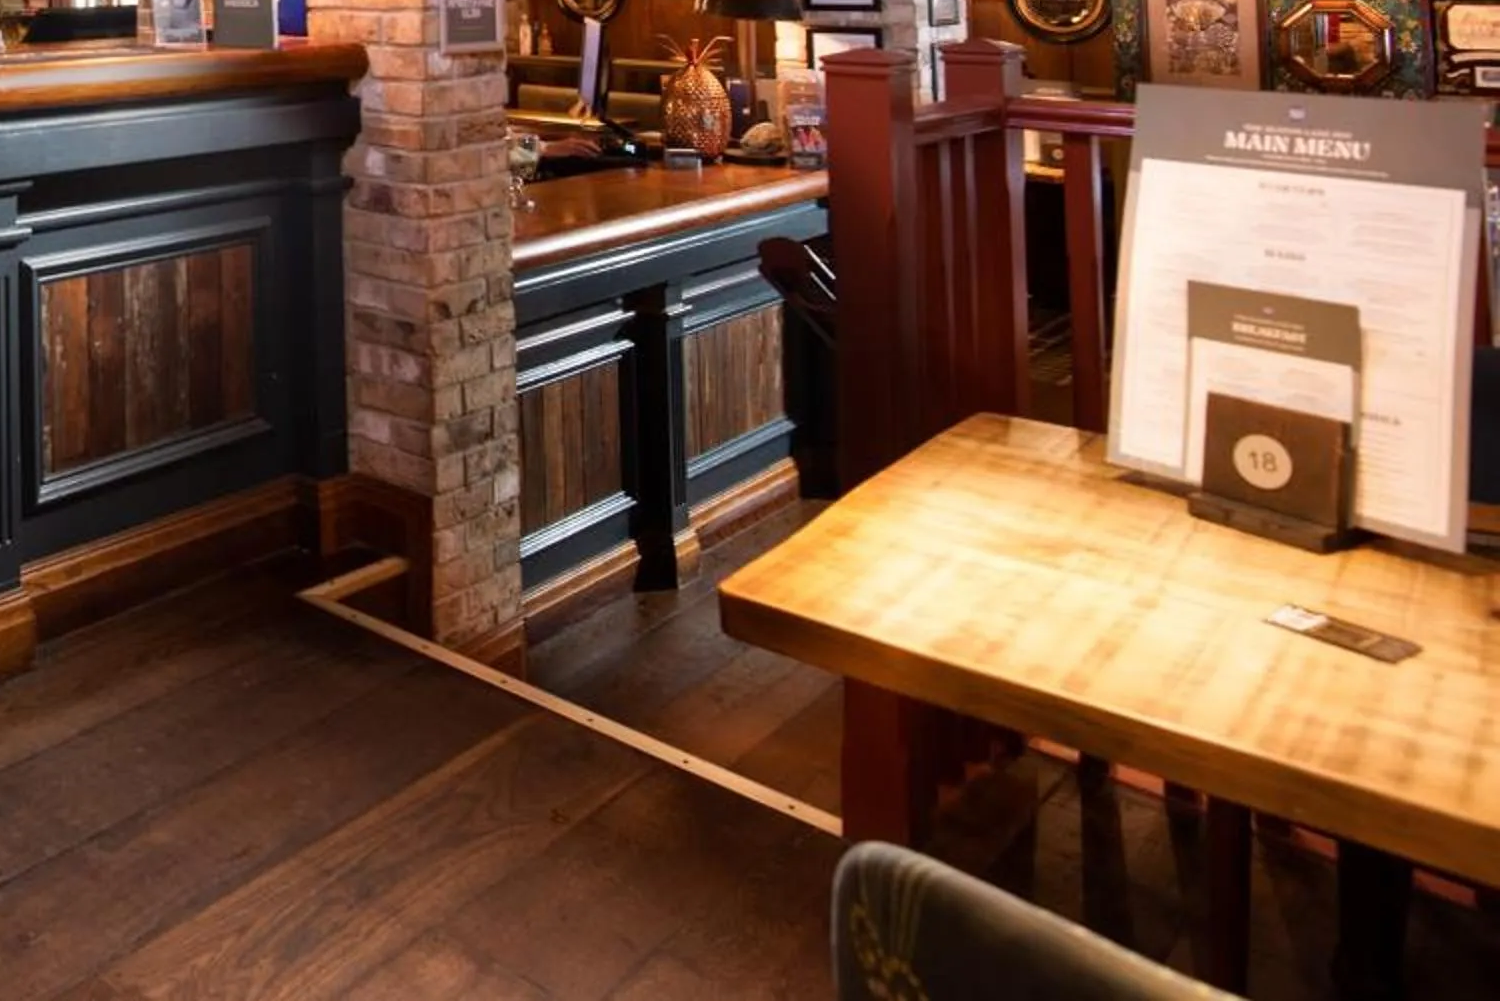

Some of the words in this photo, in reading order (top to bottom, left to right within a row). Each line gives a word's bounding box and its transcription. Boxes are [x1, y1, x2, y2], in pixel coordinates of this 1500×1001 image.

[1223, 130, 1290, 154] MAIN
[1293, 137, 1371, 162] MENU
[1247, 450, 1278, 473] 18
